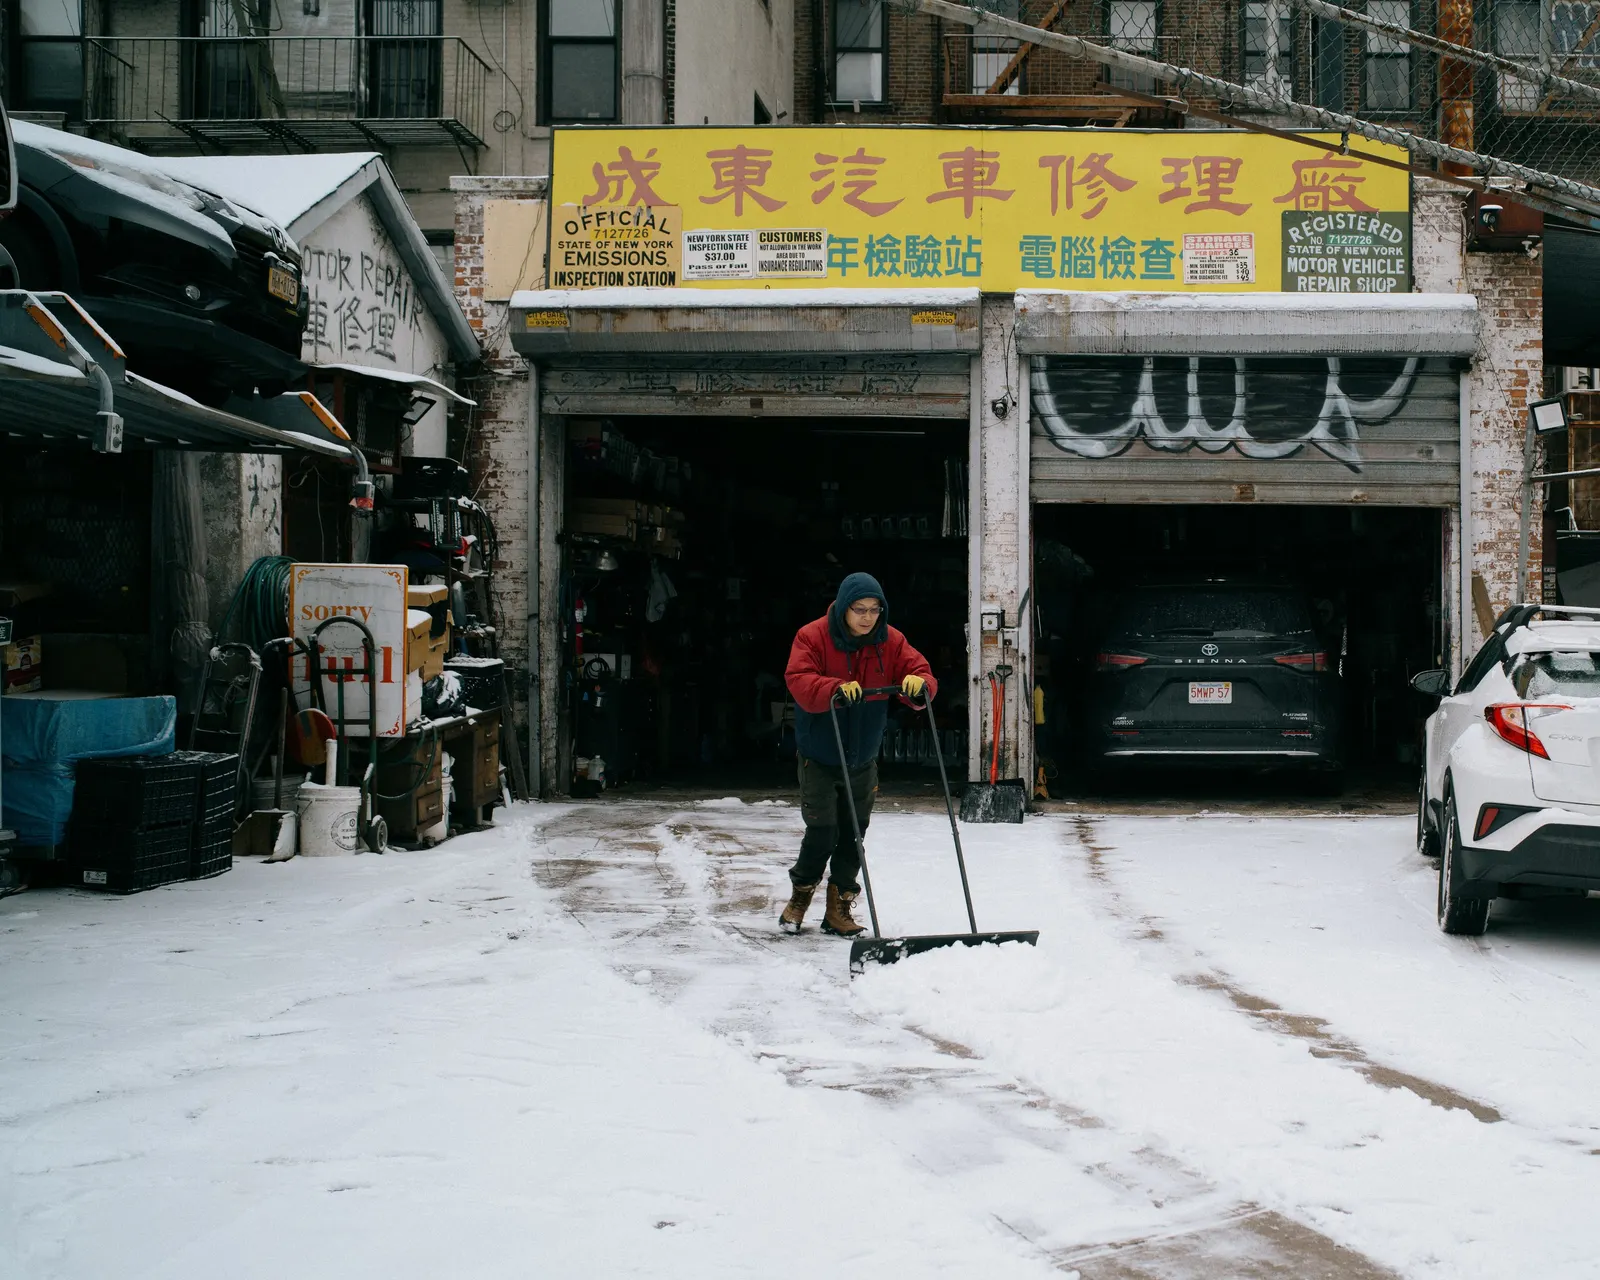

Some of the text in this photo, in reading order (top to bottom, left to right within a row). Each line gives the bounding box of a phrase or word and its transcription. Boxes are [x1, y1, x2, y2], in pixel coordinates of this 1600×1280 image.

[582, 144, 1379, 219] 成東汽車修理廠
[564, 210, 670, 235] OFFICIAL
[1288, 213, 1403, 243] REGISTERED
[594, 229, 649, 238] 7127726
[687, 235, 704, 243] NEW
[760, 232, 822, 242] CUSTOMERS
[1310, 235, 1372, 245] NO. 7127726
[558, 240, 674, 248] STATE OF NEW YORK
[689, 243, 733, 252] INSPECTION
[1288, 245, 1403, 256] STATE OF NEW YORK
[564, 251, 667, 266] EMISSIONS
[705, 252, 735, 261] $37.00
[827, 234, 982, 278] 年檢驗站
[1019, 234, 1183, 280] 電腦檢查
[759, 260, 823, 272] INSURANCE REGULATIONS
[1287, 257, 1405, 274] MOTOR VEHICLE
[554, 272, 676, 286] INSPECTION STATION
[1298, 276, 1396, 292] REPAIR SHOP
[301, 245, 424, 338] OTOR REPAIR
[301, 604, 373, 623] sorry
[1191, 688, 1230, 698] 5MWP 57
